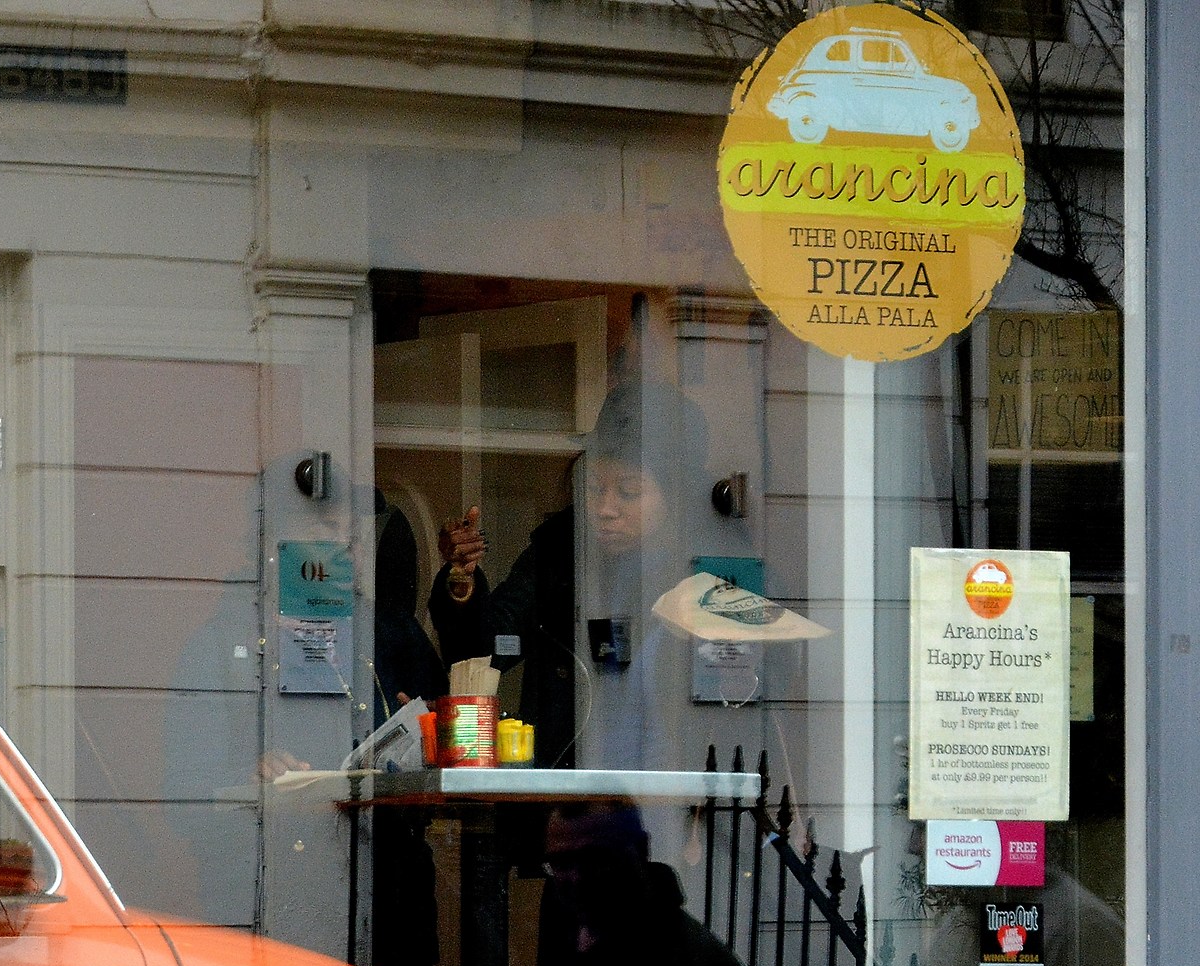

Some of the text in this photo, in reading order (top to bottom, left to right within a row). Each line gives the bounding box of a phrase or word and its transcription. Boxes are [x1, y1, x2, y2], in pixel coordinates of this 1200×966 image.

[727, 154, 1020, 208] arancina
[789, 227, 956, 254] THE ORIGINAL
[807, 257, 939, 298] PIZZA
[807, 304, 938, 328] ALLA PALA
[998, 317, 1110, 358] COME IN
[1088, 368, 1113, 382] AND
[943, 623, 1039, 641] Arancina's
[927, 649, 985, 670] Happy
[936, 691, 1044, 704] HELLO WEEK END!
[961, 706, 1020, 718] Every Friday
[941, 720, 958, 729] buy
[968, 720, 995, 731] Spritz
[997, 721, 1012, 731] get
[1021, 721, 1040, 730] free
[927, 744, 1050, 757] PROSECCO SUNDAYS!
[937, 759, 949, 768] hr
[951, 759, 961, 768] of
[961, 759, 1009, 769] bottomless
[1011, 762, 1050, 771] prosecco
[931, 773, 940, 781] at
[942, 773, 962, 783] only
[993, 774, 1008, 783] per
[944, 834, 982, 844] amazon
[936, 847, 991, 858] restaurants
[1009, 841, 1038, 853] FREE
[983, 954, 1039, 962] WINNER 2014
